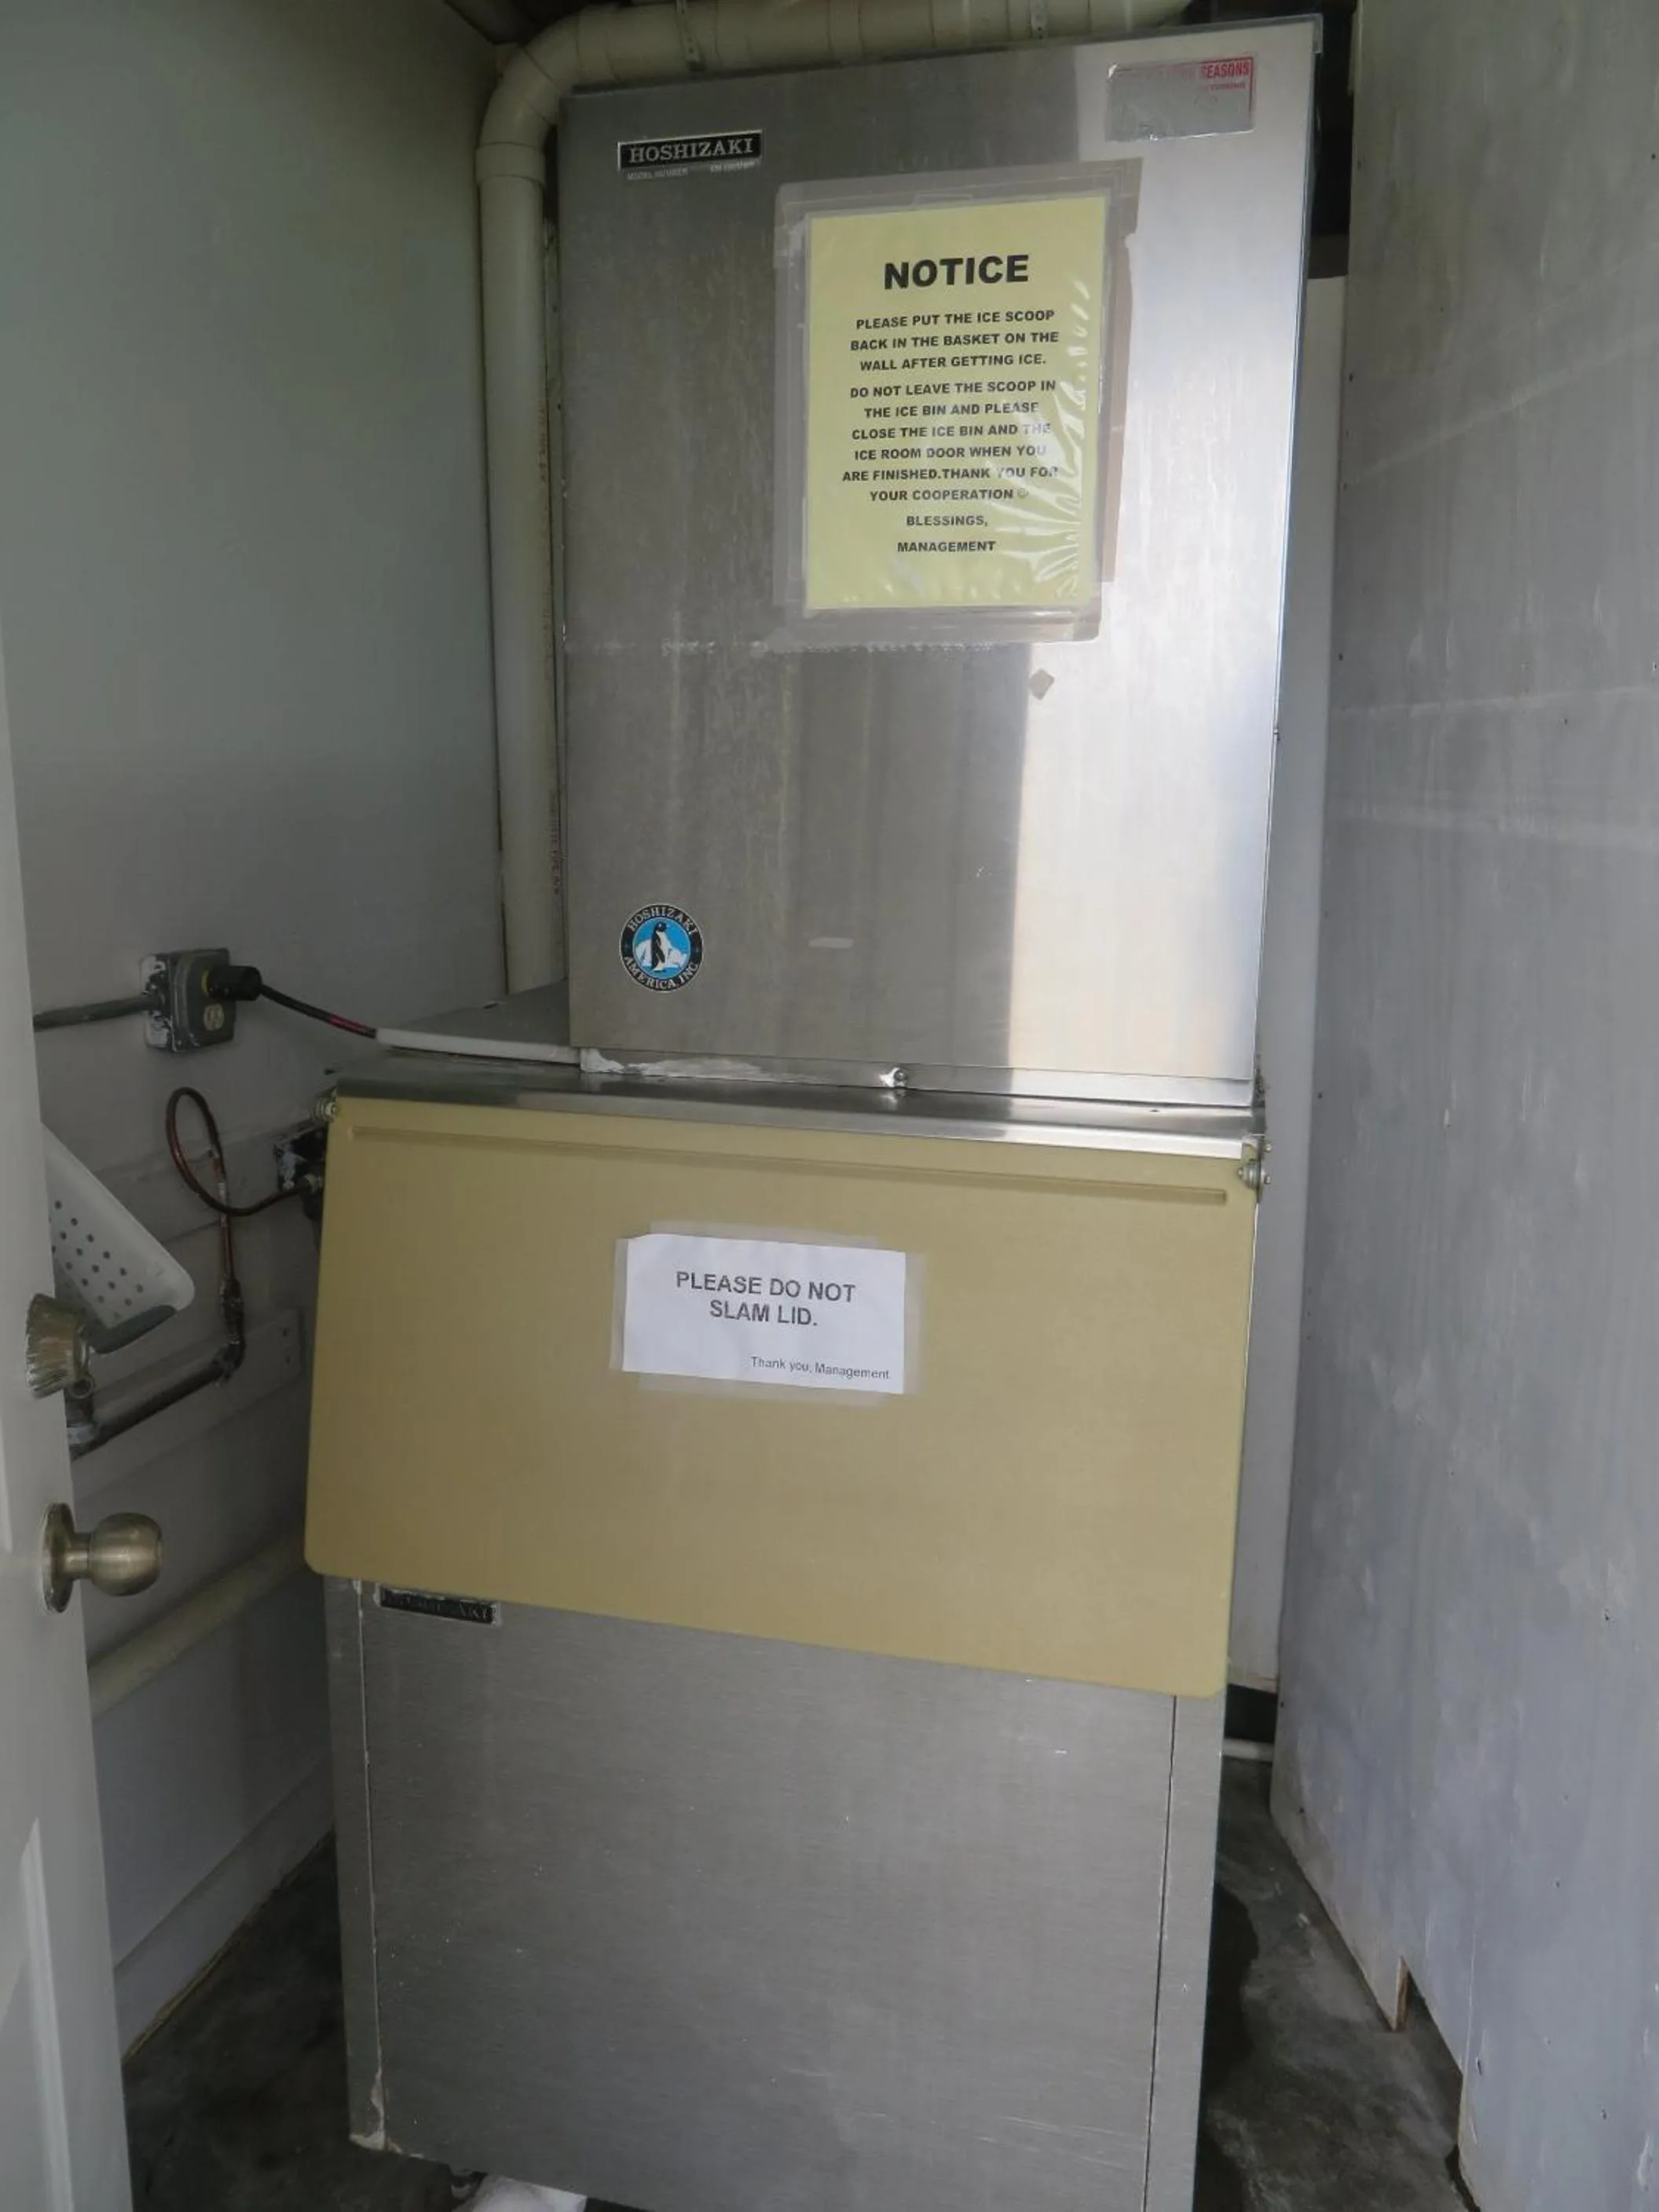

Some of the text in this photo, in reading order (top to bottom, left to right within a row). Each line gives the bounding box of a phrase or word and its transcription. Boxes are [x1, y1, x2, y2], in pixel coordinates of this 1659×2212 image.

[629, 137, 753, 163] HOSHIZAKI
[884, 255, 1028, 289] NOTICE
[857, 310, 1054, 329] PLEASE PUT THE ICE SCOOP
[851, 331, 1058, 350] BACK IN THE BASKET ON THE
[861, 353, 1046, 371] WALL AFTER GETTING ICE.
[851, 380, 1055, 397] DO NOT LEAVE THE SCOOP IN
[864, 402, 1038, 418] THE ICE BIN AND PLEASE
[852, 423, 1051, 439] CLOSE THE ICE BIN AND THE
[855, 445, 1046, 460] ICE ROOM DOOR WHEN YOU
[843, 471, 868, 481] ARE
[996, 467, 1025, 478] YOU
[870, 489, 1013, 501] YOUR COOPERATION
[906, 516, 987, 526] BLESSINGS,
[898, 541, 996, 551] MANAGEMENT
[628, 906, 698, 935] HOSHIZAKI
[677, 1272, 855, 1302] PLEASE DO NOT
[710, 1300, 817, 1326] SLAM LID.
[751, 1357, 888, 1379] Thank you, Management
